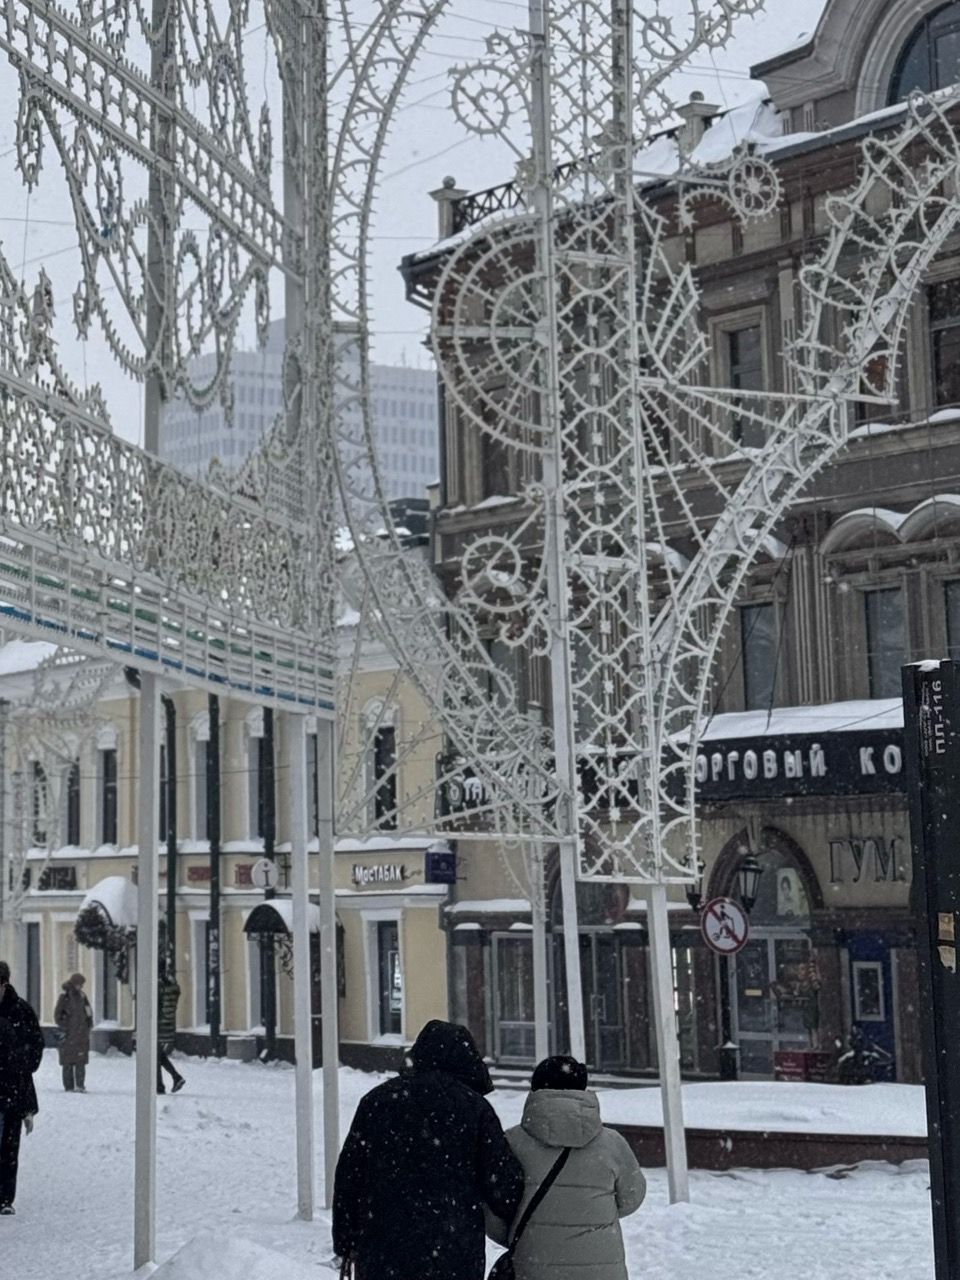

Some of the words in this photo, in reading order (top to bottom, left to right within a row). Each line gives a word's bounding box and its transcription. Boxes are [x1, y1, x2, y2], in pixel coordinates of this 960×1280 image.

[695, 743, 827, 783] ОРГОВЫЙ
[859, 744, 903, 775] КО
[828, 836, 906, 883] ГУМ
